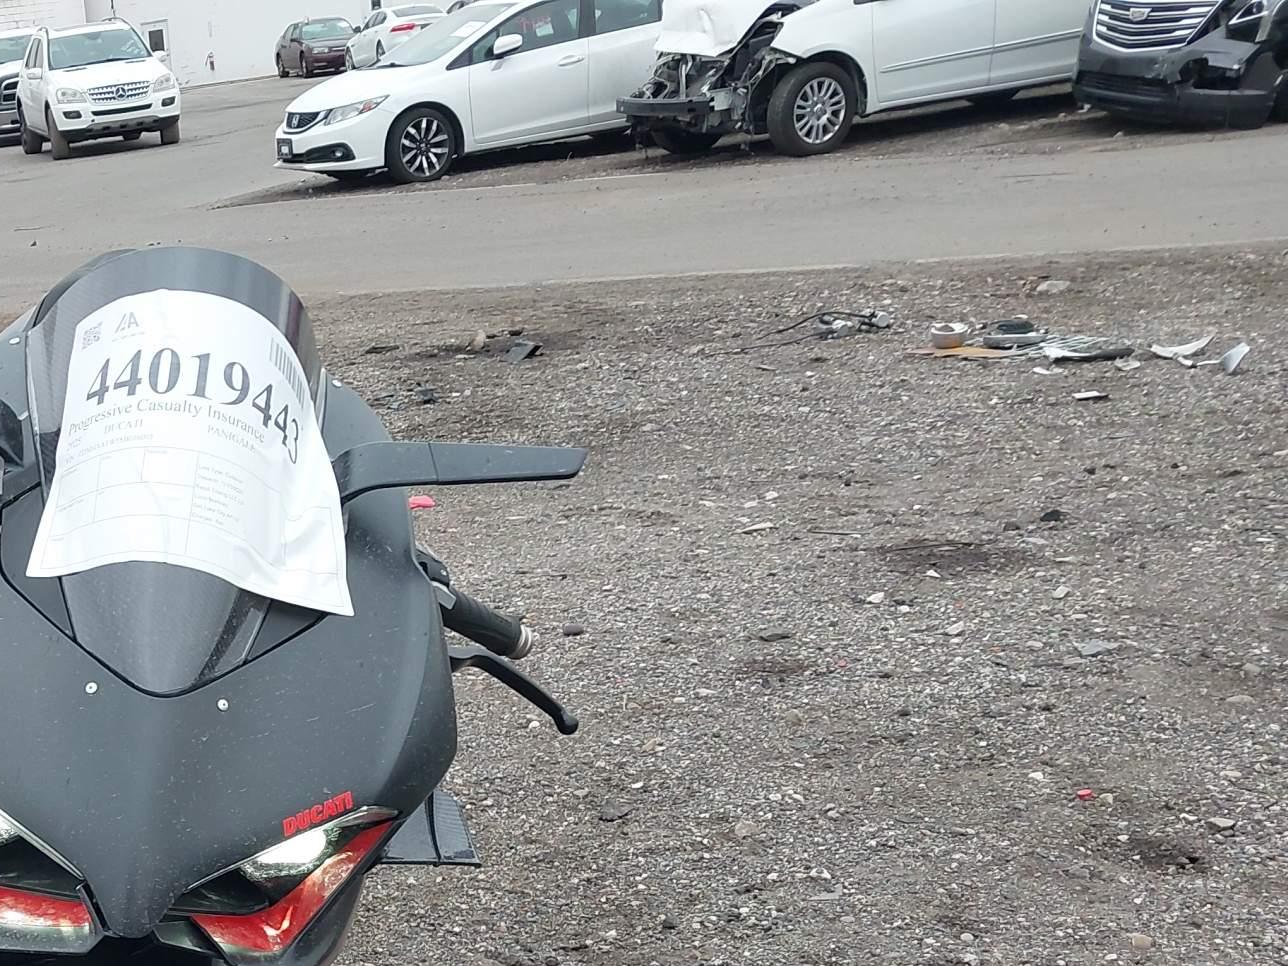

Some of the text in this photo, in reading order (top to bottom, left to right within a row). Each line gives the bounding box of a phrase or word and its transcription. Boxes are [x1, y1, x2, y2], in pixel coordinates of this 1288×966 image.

[68, 398, 266, 444] Progressive Casualty Insurance
[86, 346, 299, 465] 44019443
[283, 791, 352, 837] DUCATI
